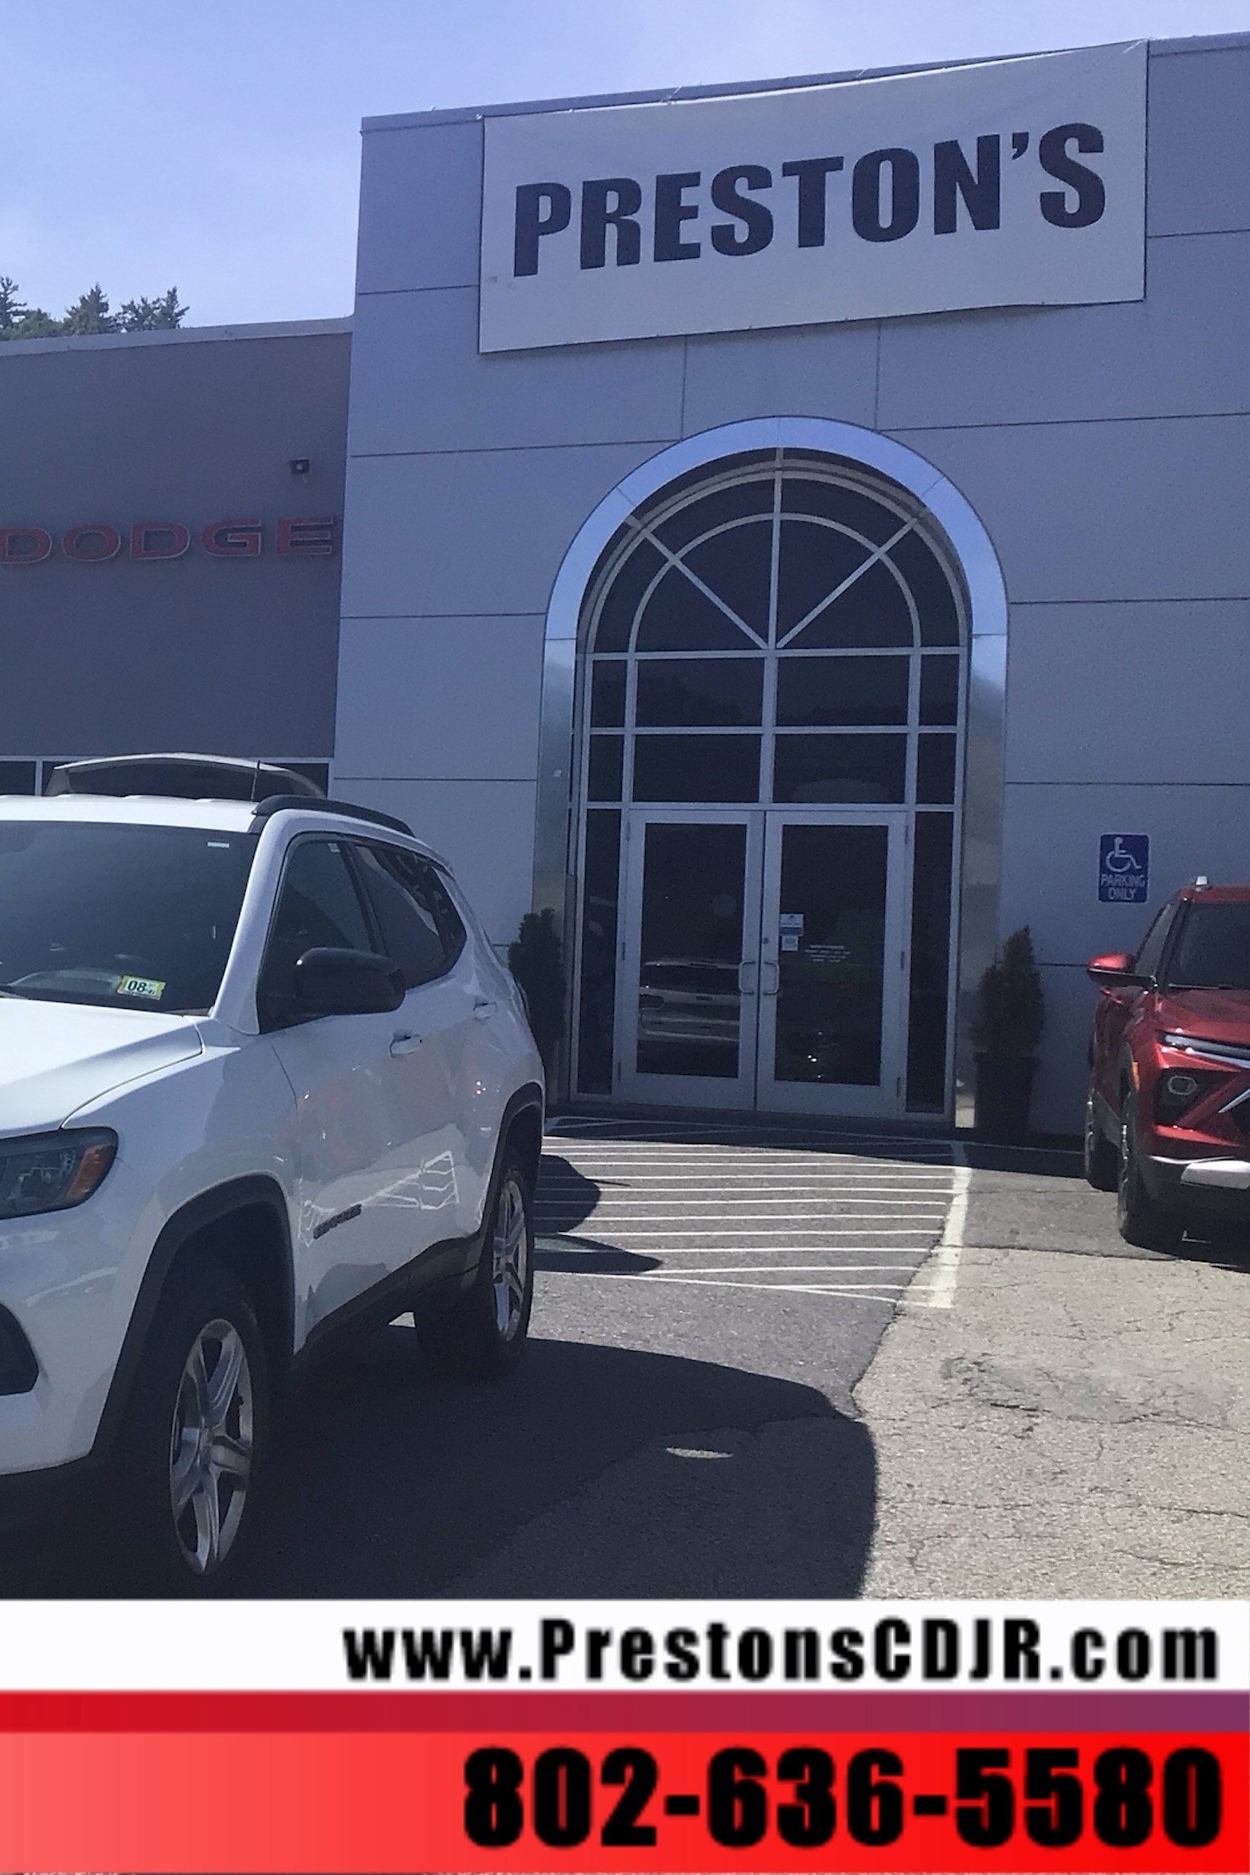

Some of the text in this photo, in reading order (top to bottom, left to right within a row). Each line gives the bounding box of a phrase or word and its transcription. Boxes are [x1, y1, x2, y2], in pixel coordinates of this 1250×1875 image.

[513, 122, 1106, 278] PRESTON'S
[1101, 873, 1146, 888] PARKING
[1108, 887, 1137, 900] ONLY
[127, 980, 148, 993] 08
